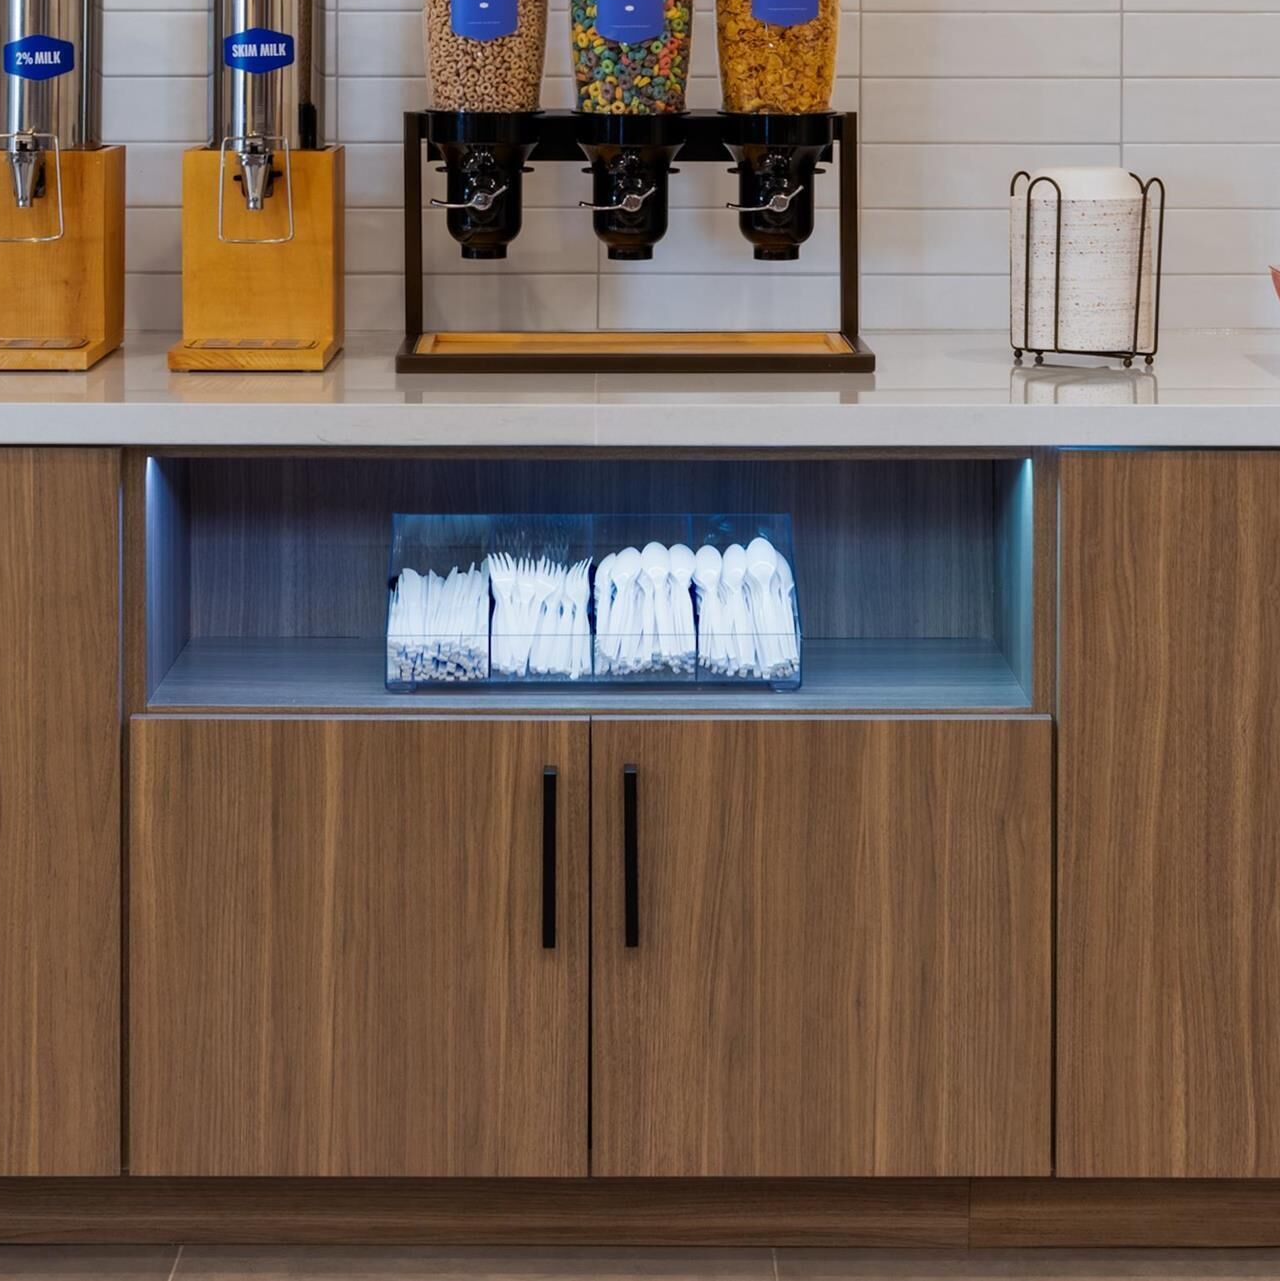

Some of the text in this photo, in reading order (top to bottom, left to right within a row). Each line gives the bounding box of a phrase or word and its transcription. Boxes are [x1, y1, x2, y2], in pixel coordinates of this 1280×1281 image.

[232, 43, 286, 57] SKIM MILK
[15, 50, 61, 65] 2% MILK
